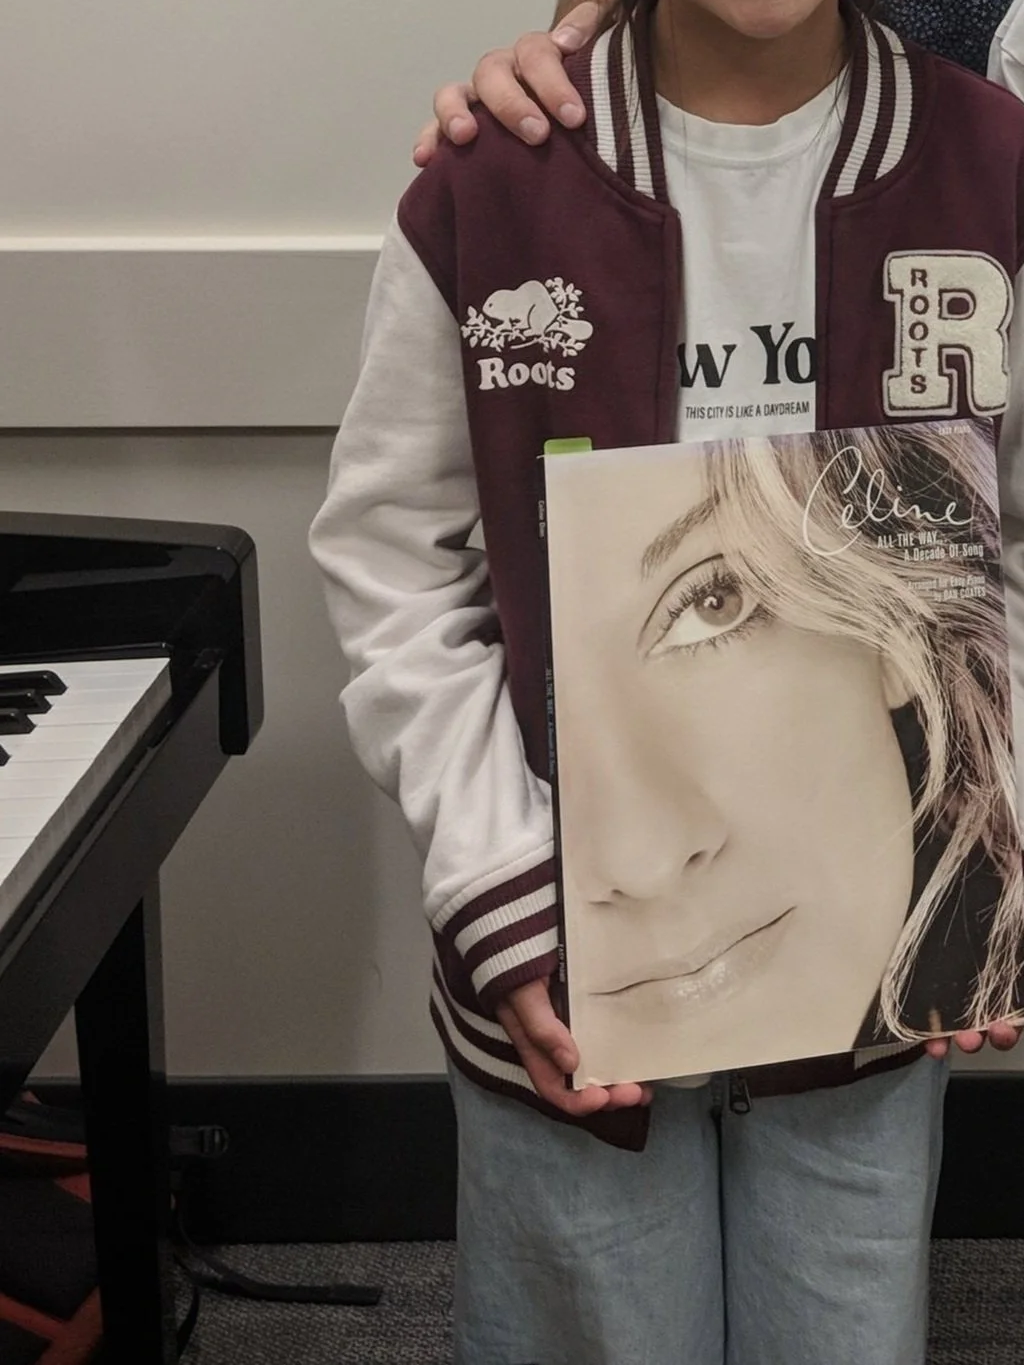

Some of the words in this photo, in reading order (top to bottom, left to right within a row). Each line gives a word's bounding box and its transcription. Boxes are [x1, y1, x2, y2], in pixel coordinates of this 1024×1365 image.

[909, 268, 930, 394] ROOTS
[477, 357, 575, 391] Roots
[685, 406, 705, 419] THIS
[707, 406, 724, 419] CITY
[725, 405, 733, 418] IS
[736, 405, 753, 418] LIKE
[755, 405, 761, 417] A
[763, 401, 810, 416] DAYDREAM
[877, 535, 894, 549] ALL
[897, 533, 914, 547] THE
[904, 549, 910, 561] A
[913, 546, 946, 561] Decade
[962, 543, 984, 558] Song
